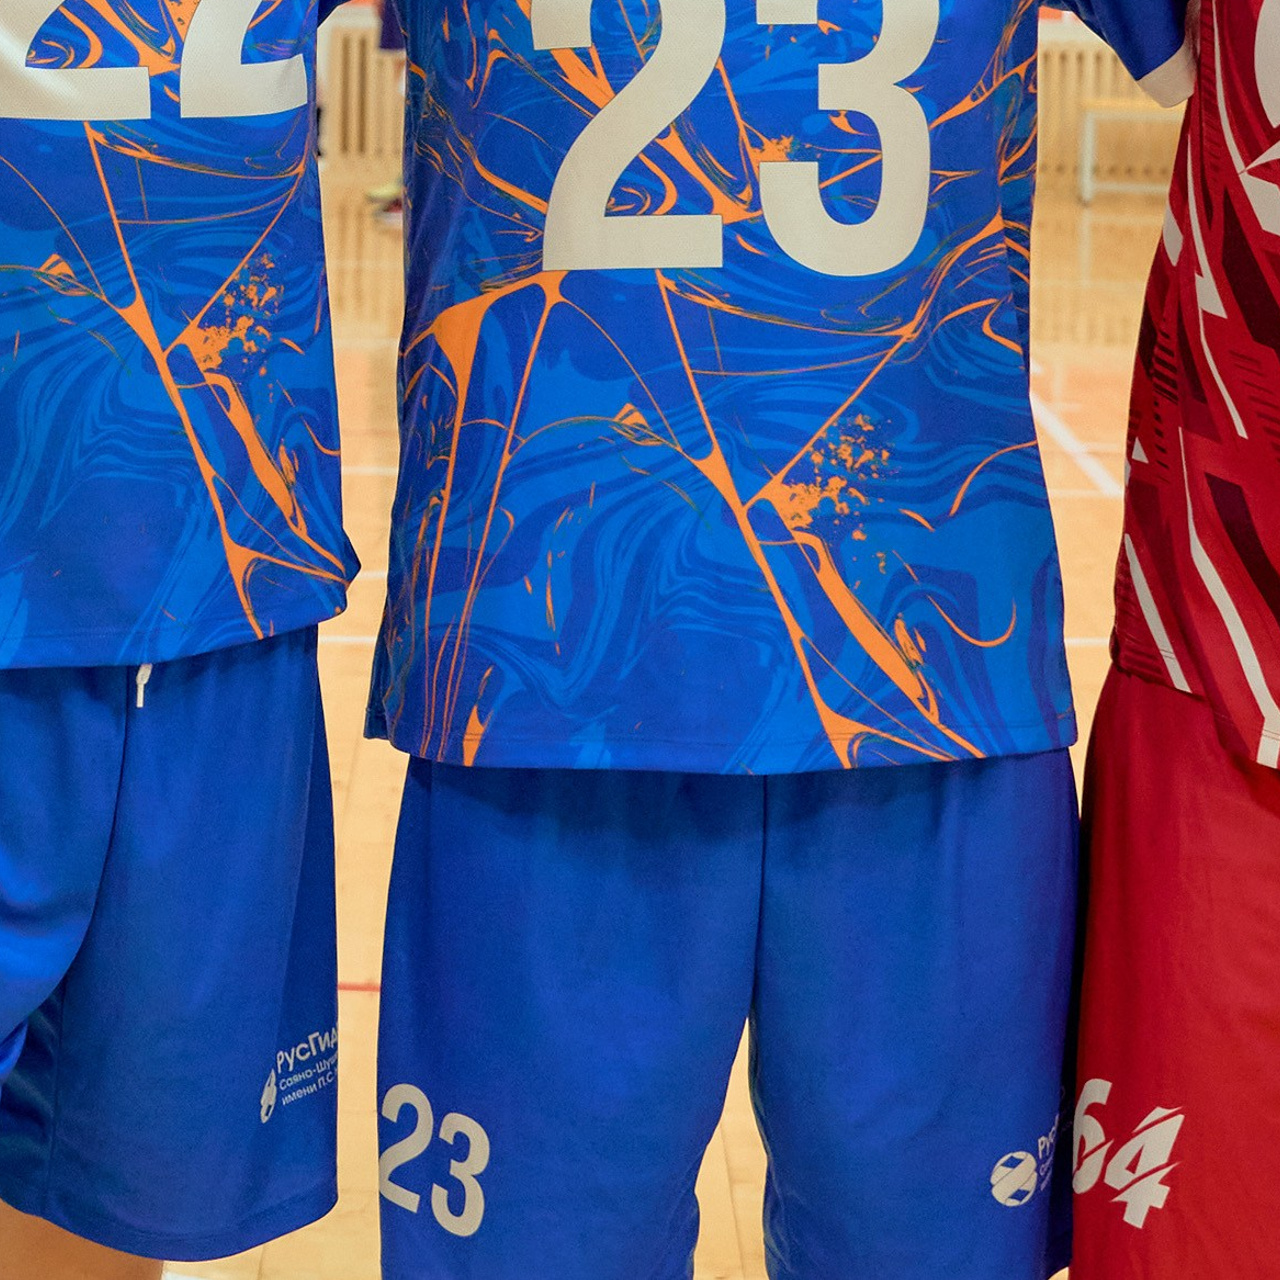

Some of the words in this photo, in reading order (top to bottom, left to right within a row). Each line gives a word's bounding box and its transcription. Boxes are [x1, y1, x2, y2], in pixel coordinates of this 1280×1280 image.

[281, 1083, 317, 1106] имени
[379, 1083, 491, 1237] 23
[1072, 1078, 1185, 1229] 64
